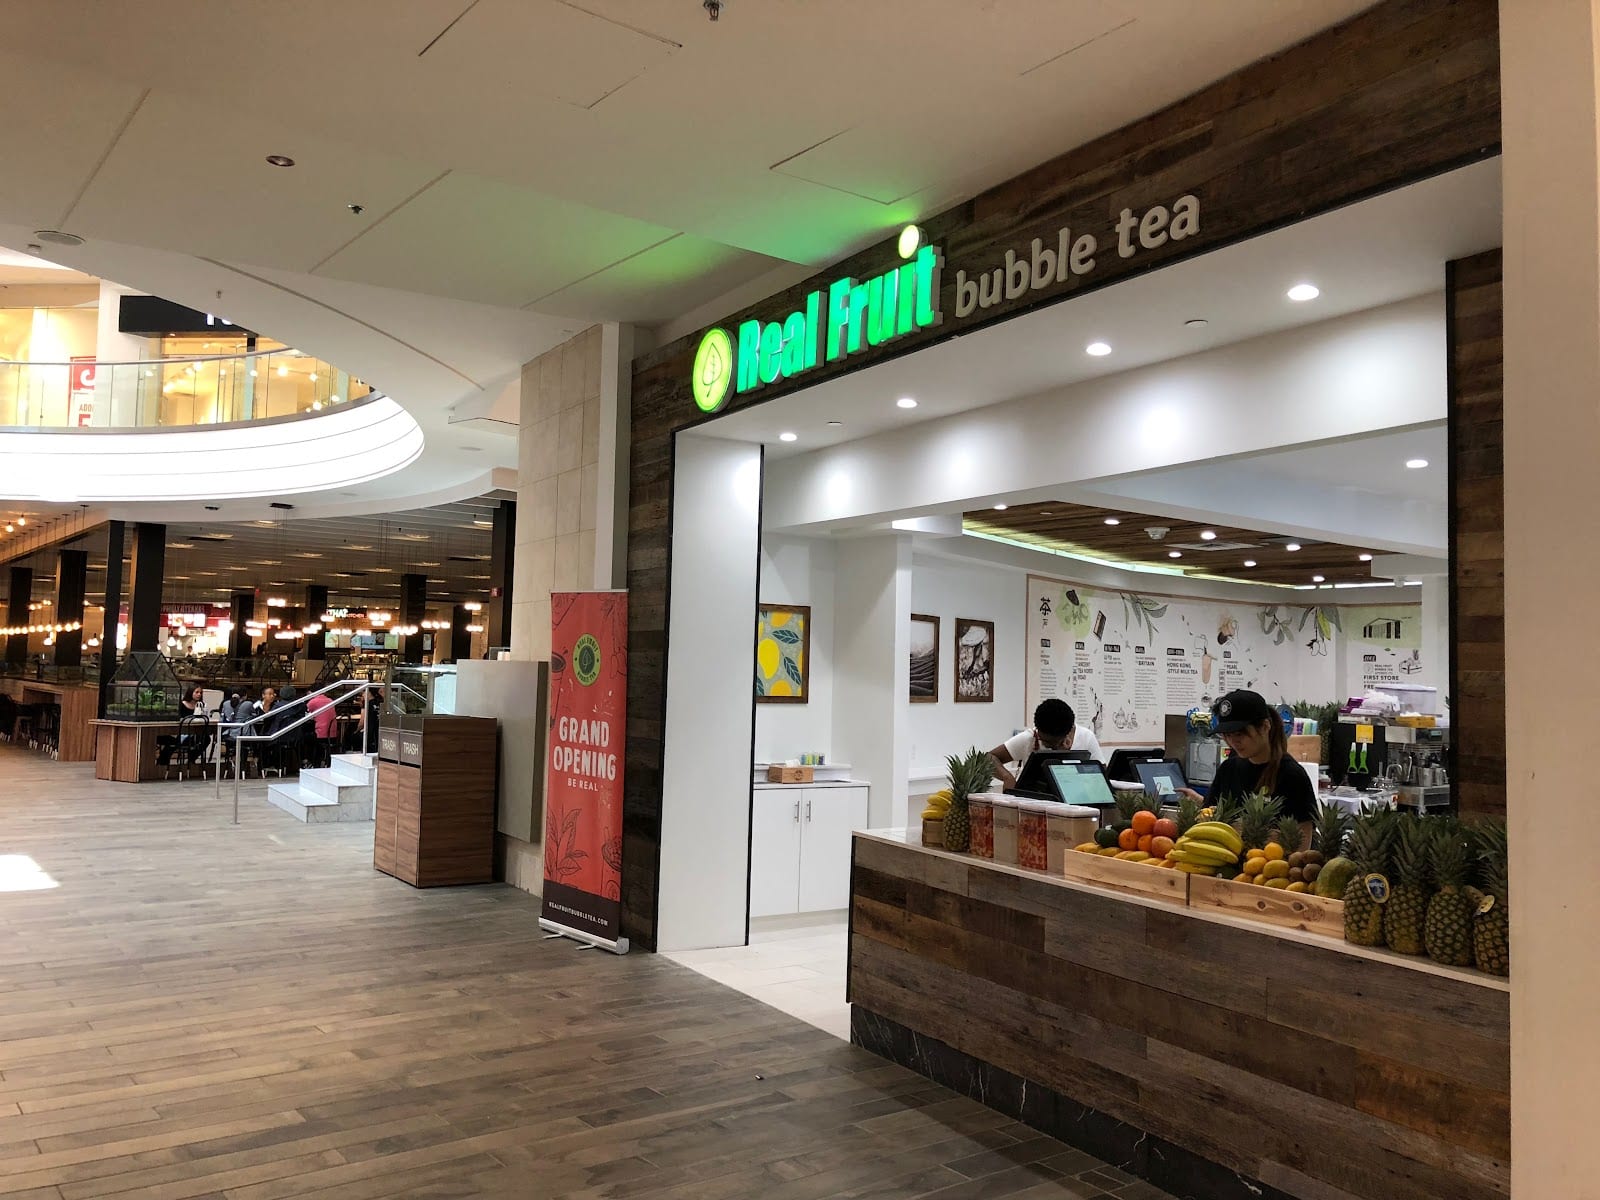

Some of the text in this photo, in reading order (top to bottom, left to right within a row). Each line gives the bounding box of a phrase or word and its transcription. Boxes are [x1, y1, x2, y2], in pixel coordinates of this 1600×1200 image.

[737, 194, 1201, 393] Real Fruit bubble tea
[1040, 597, 1052, 616] 茶
[559, 715, 610, 748] GRAND
[381, 738, 397, 752] TRASH
[403, 741, 419, 757] TRASH
[553, 745, 617, 781] OPENING
[567, 777, 599, 792] BE REAL
